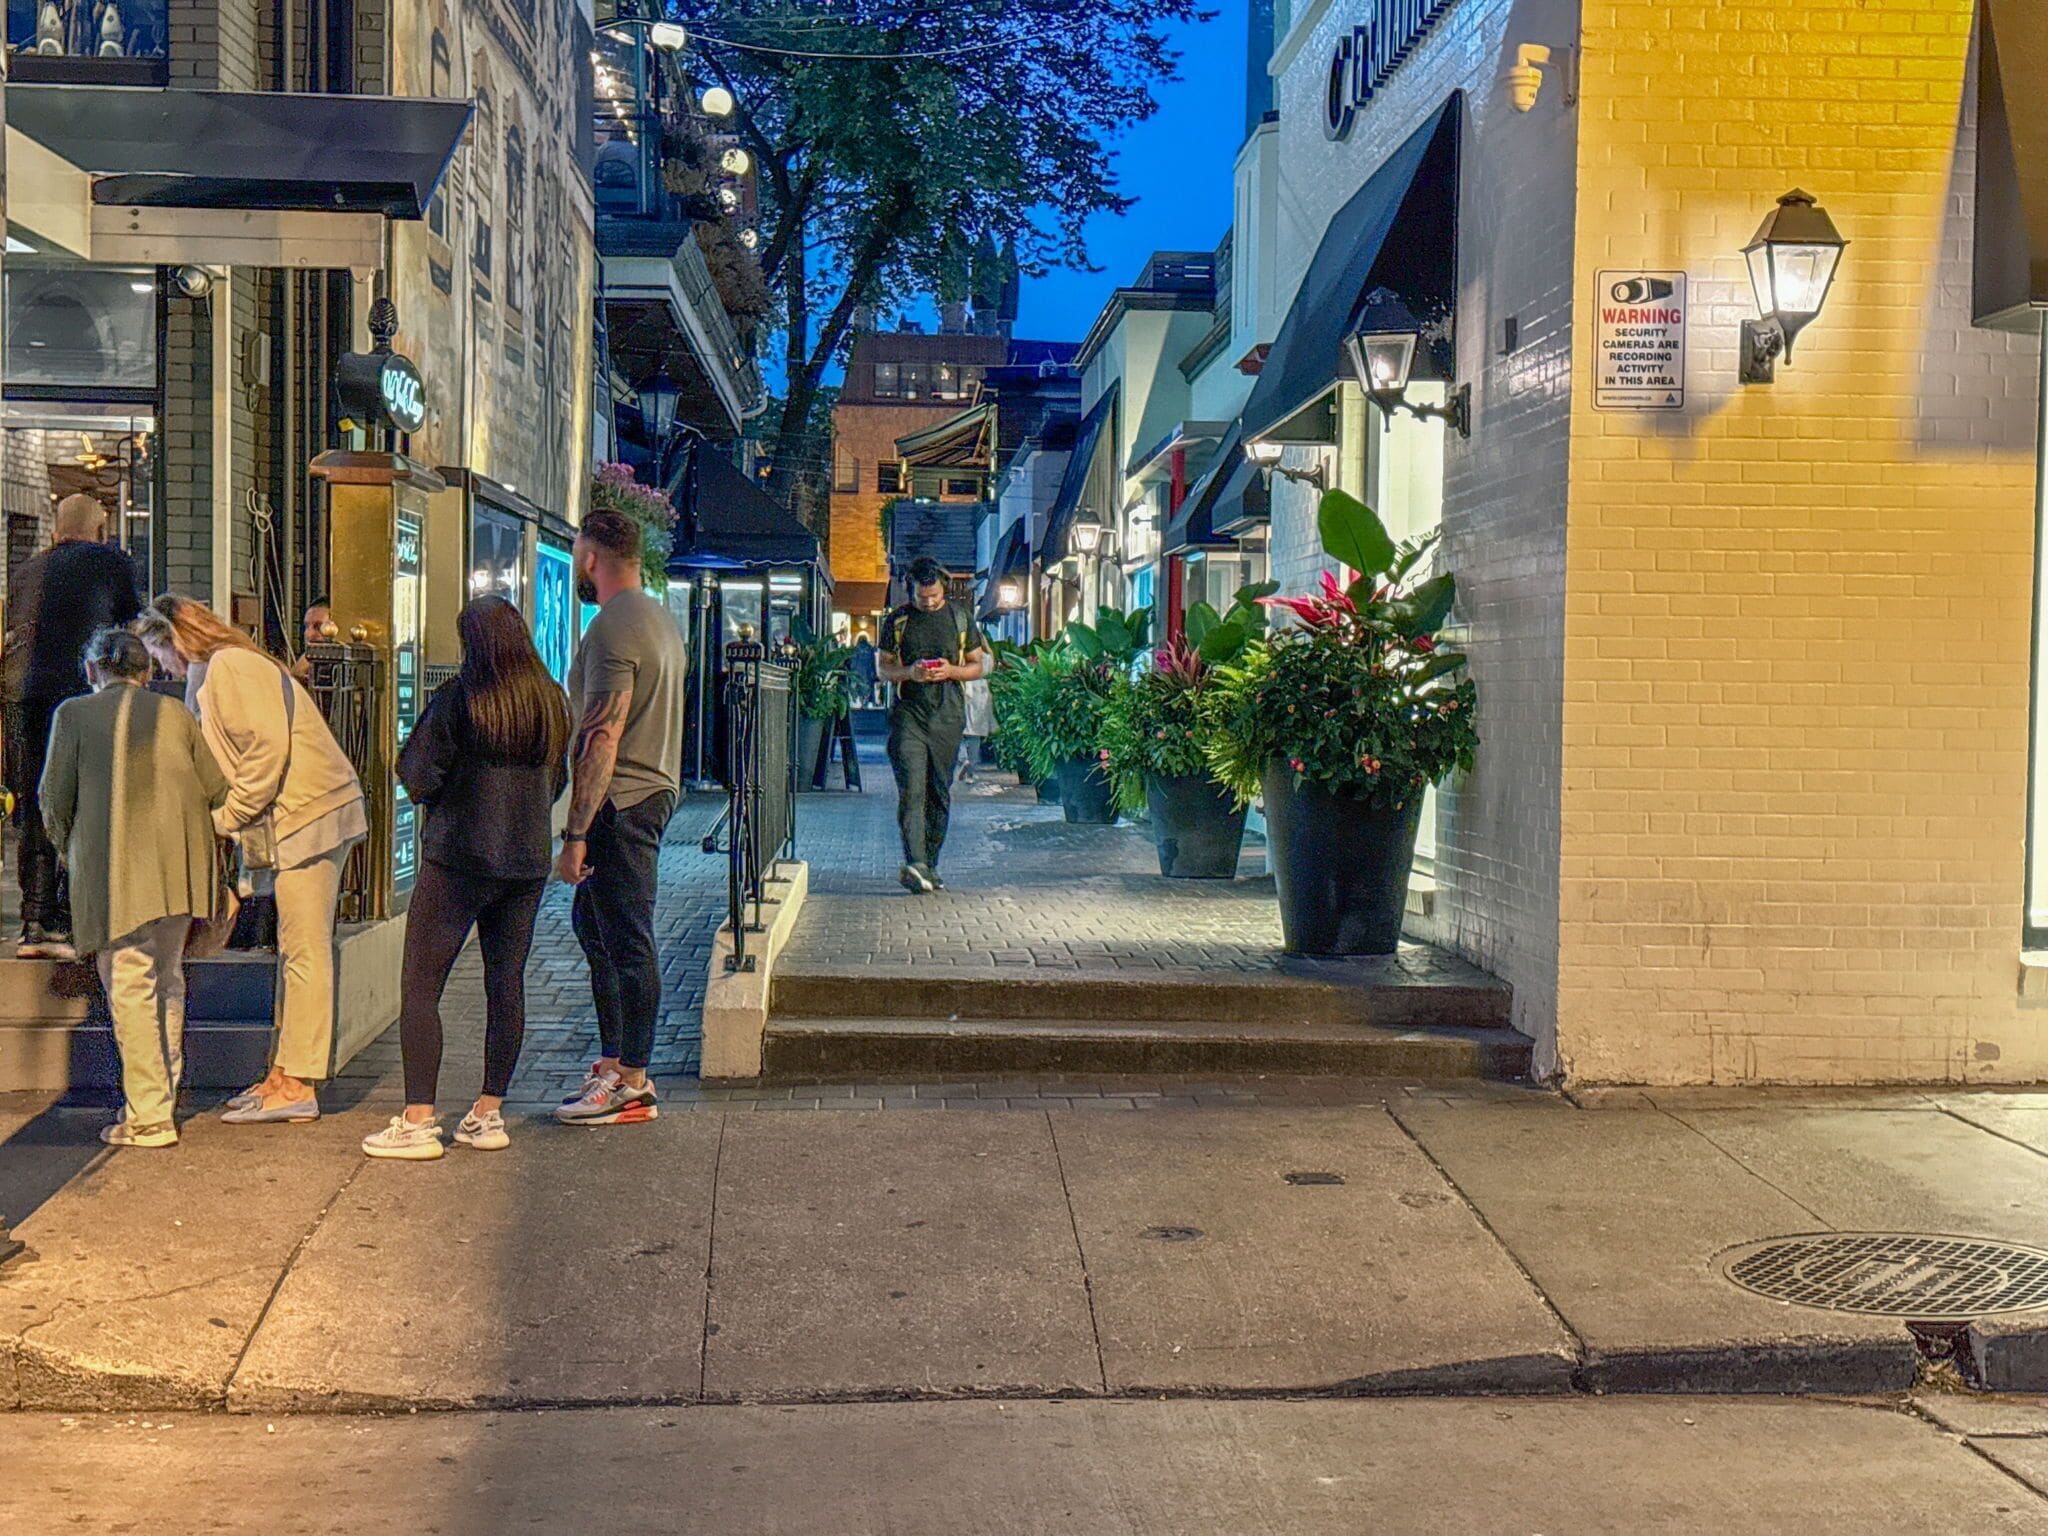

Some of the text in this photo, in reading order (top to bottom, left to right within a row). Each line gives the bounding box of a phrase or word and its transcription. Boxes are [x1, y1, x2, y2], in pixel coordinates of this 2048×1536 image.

[1602, 308, 1681, 324] WARNING
[1615, 328, 1668, 337] SECURITY
[1603, 340, 1679, 349] CAMERAS ARE
[1609, 352, 1672, 361] RECORDING
[1616, 364, 1664, 373] ACTIVITY
[1605, 376, 1676, 385] IN THIS AREA
